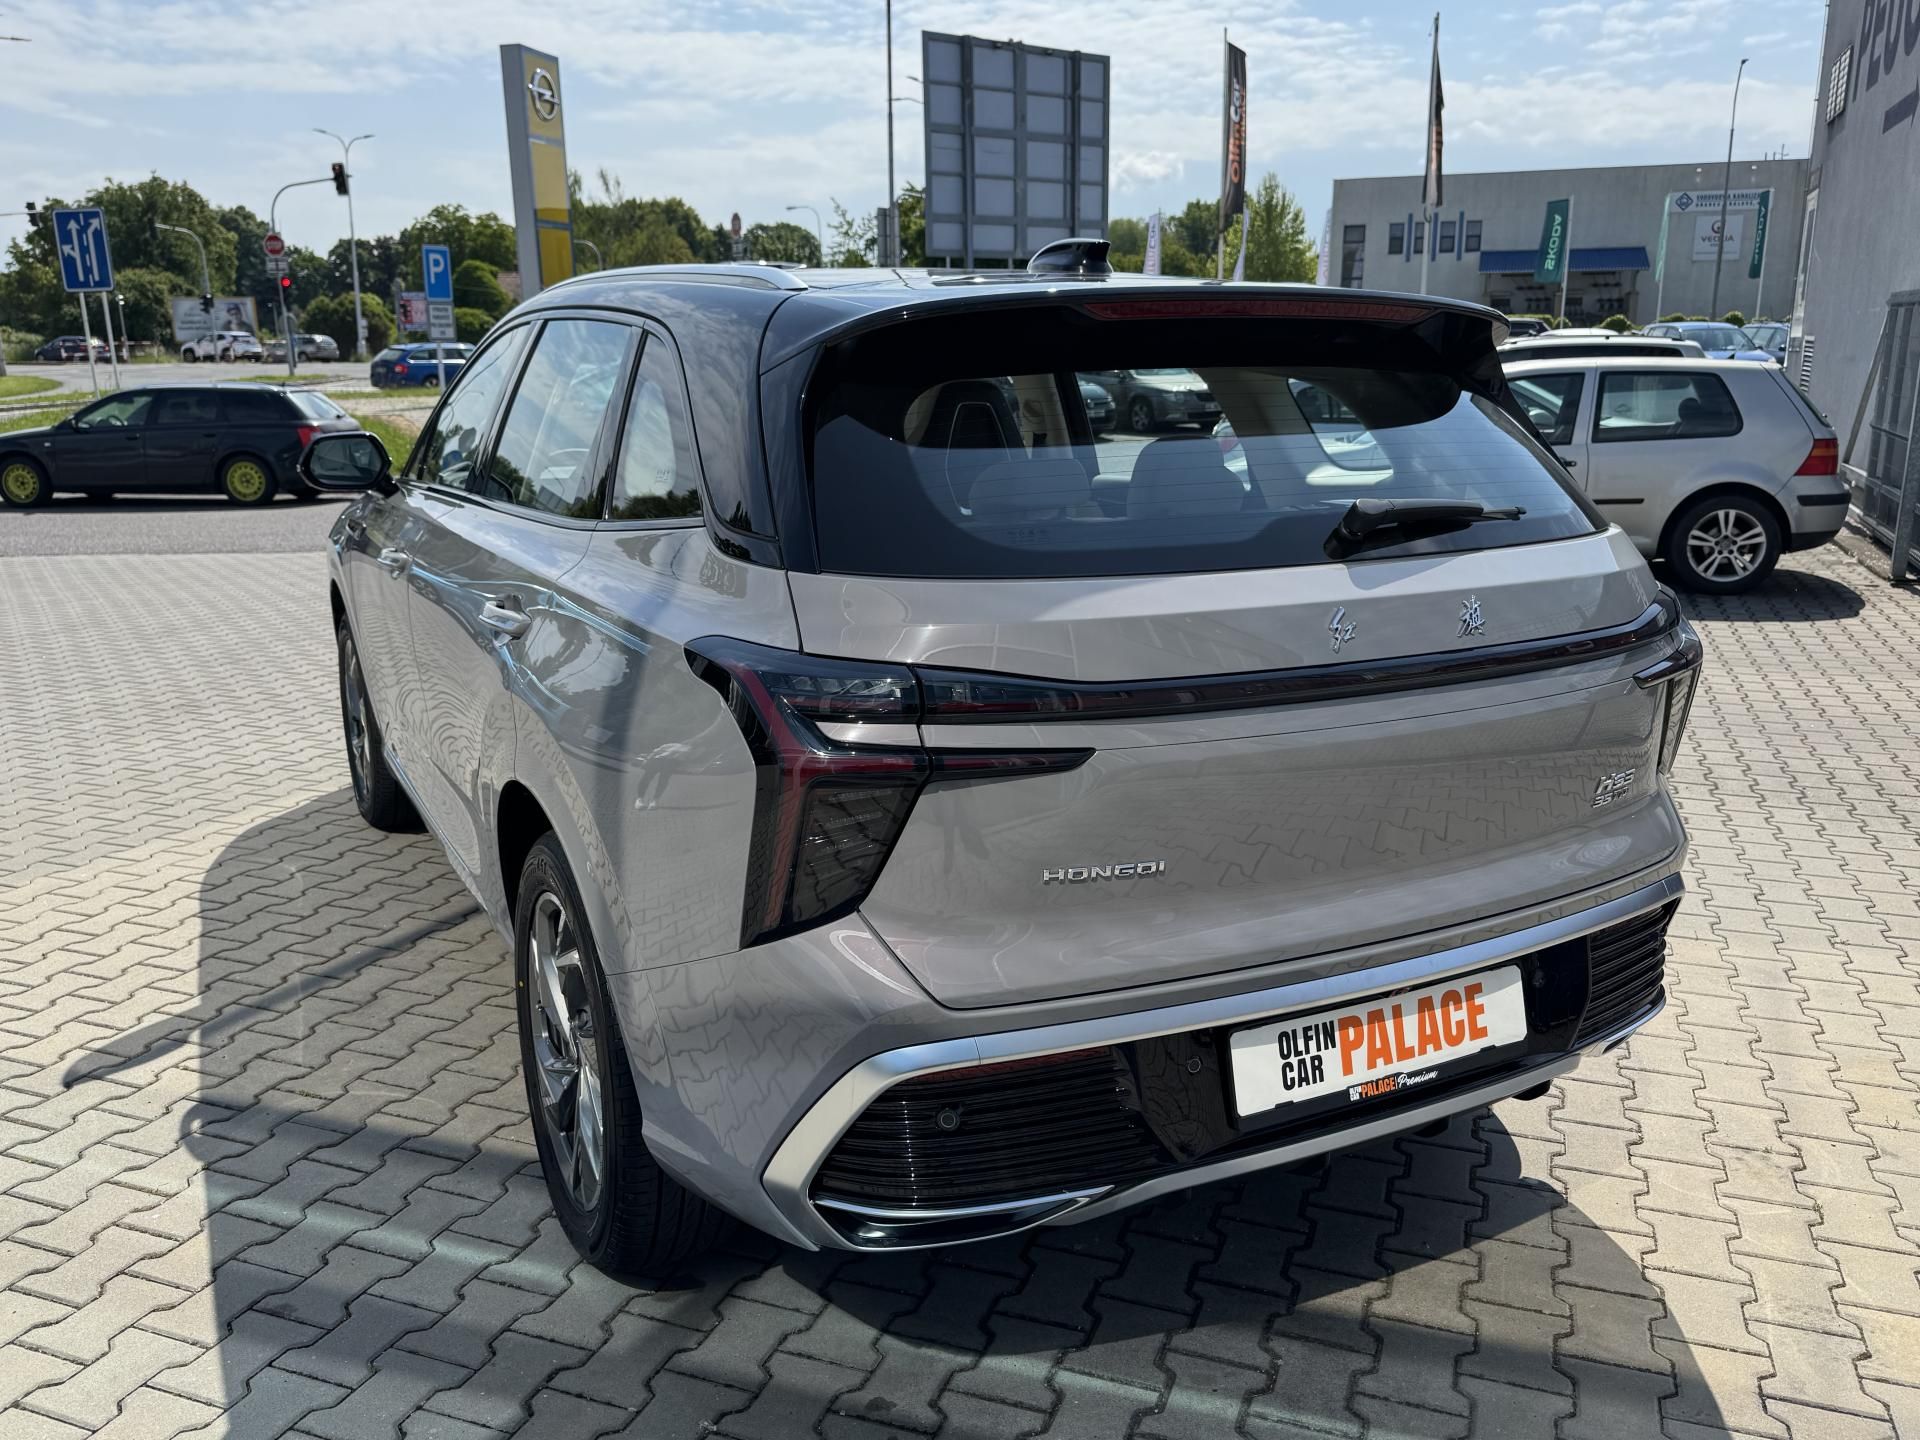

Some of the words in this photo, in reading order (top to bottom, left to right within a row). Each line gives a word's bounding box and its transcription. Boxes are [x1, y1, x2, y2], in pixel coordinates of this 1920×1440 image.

[428, 253, 444, 284] P
[1043, 860, 1165, 882] HONGQI
[1277, 1020, 1337, 1061] OLFIN
[1337, 982, 1489, 1077] PALACE
[1281, 1054, 1325, 1091] CAR
[1361, 1076, 1396, 1098] PALACE
[1398, 1070, 1438, 1088] Premium
